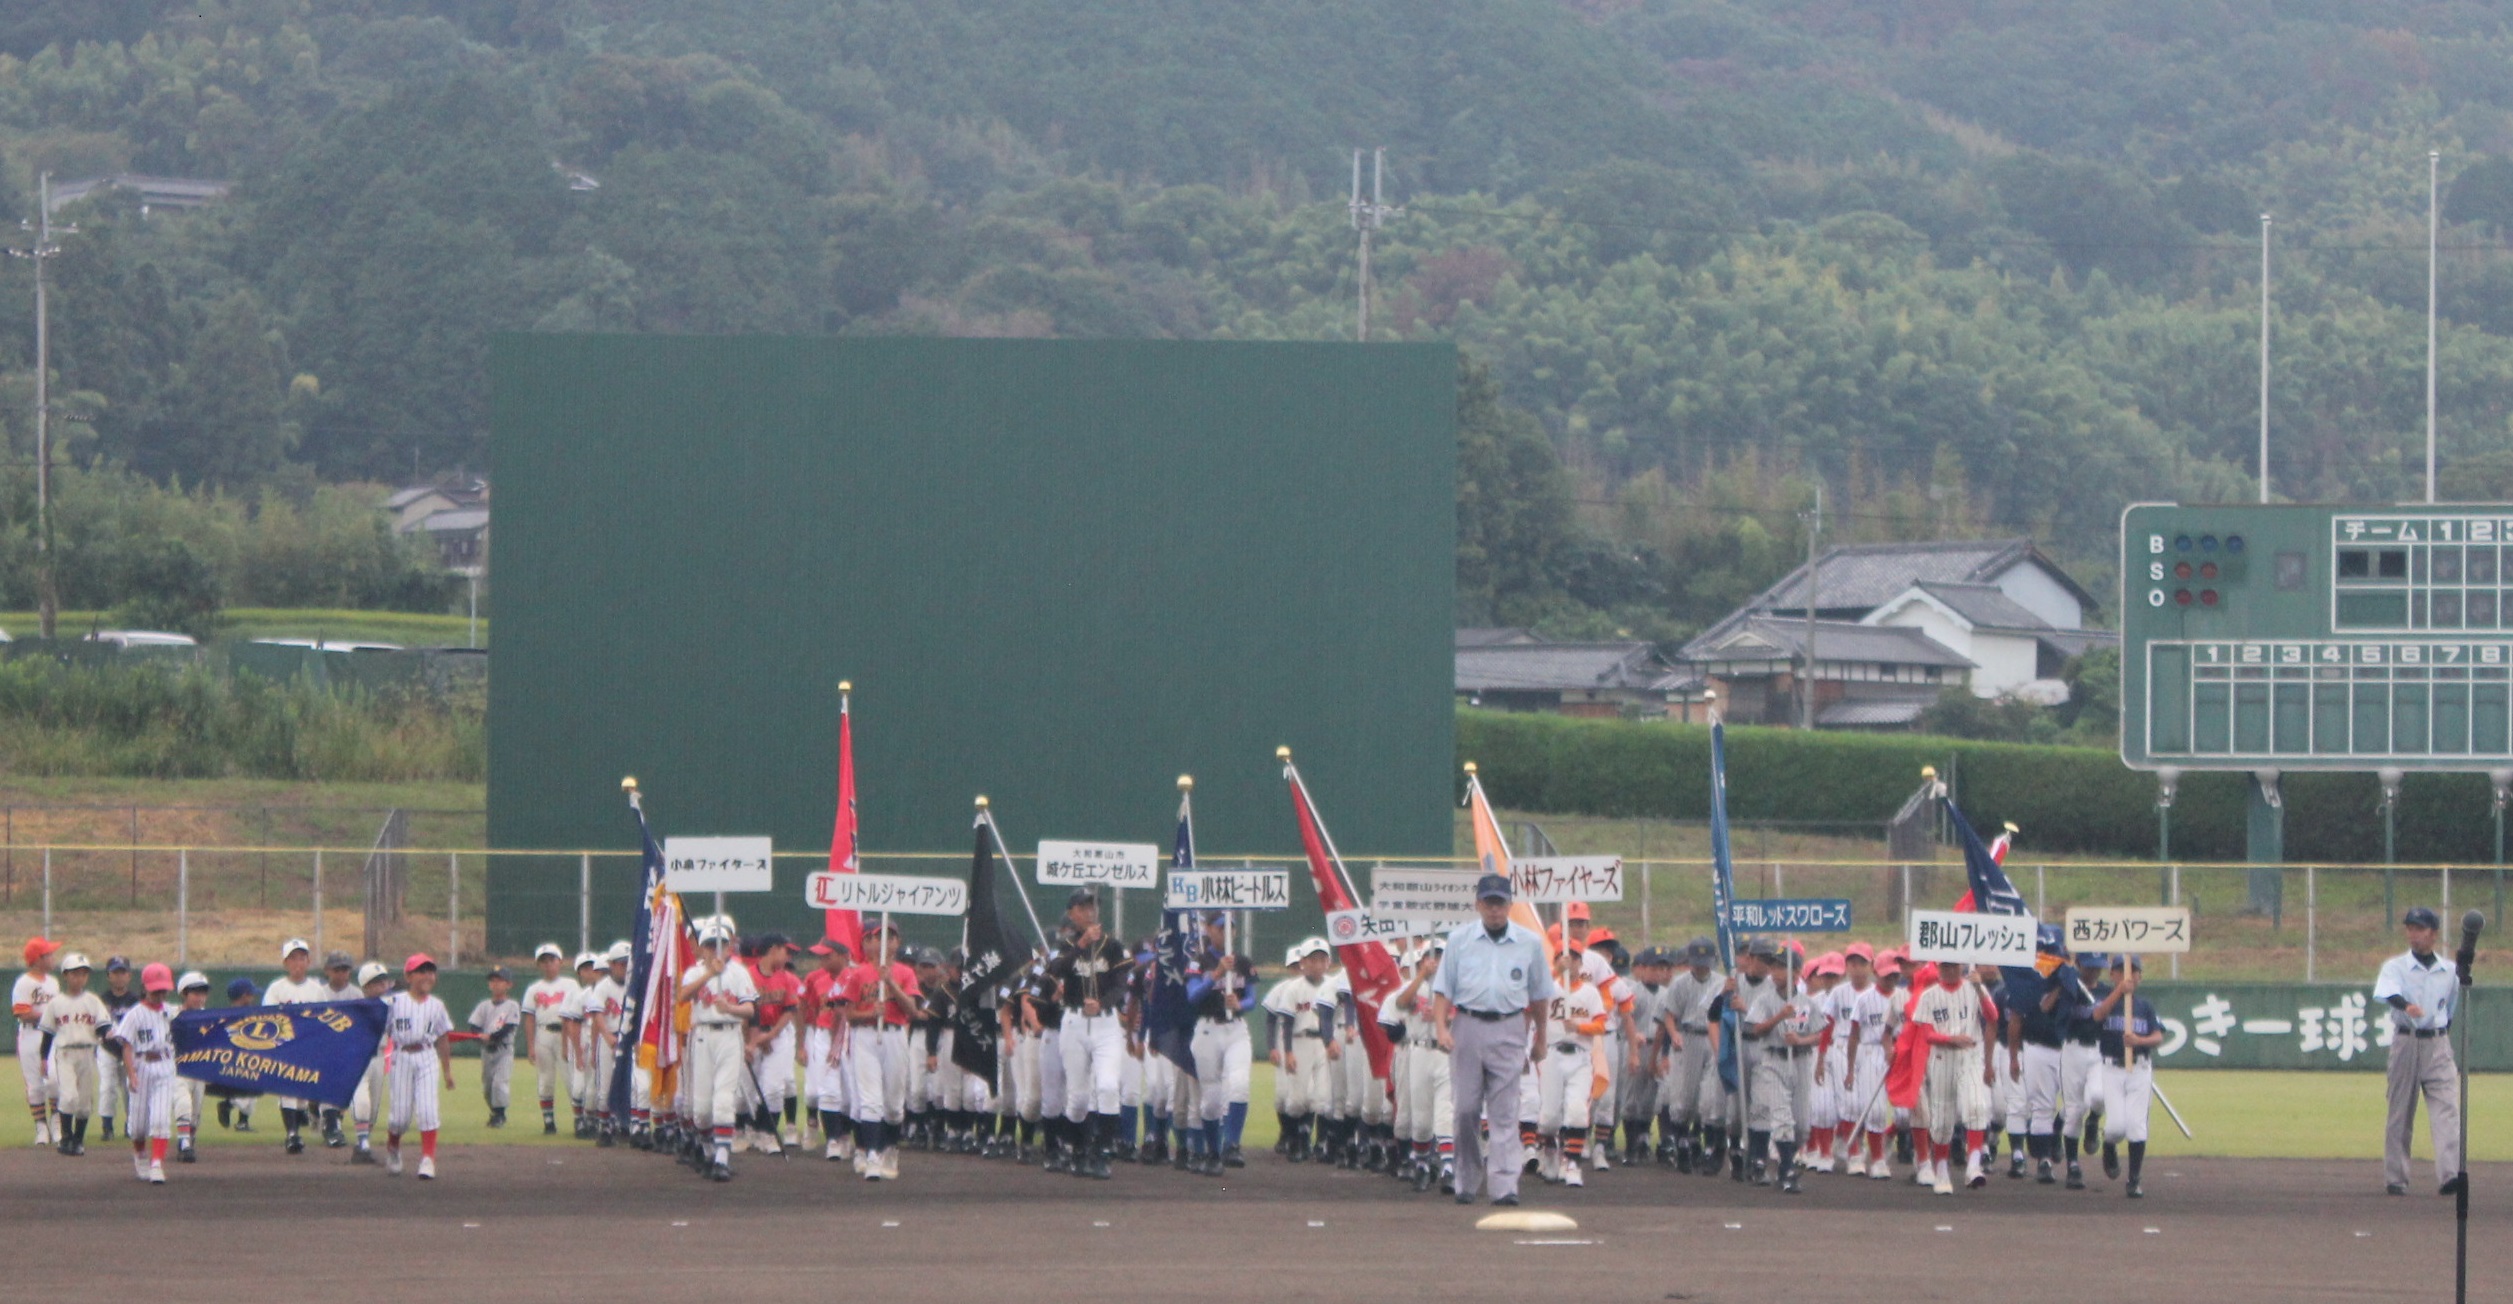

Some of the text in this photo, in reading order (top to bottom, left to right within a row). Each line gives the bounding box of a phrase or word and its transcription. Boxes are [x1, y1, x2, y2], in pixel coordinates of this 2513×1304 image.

[2345, 521, 2418, 541] チーム
[2439, 521, 2453, 541] 1
[2470, 521, 2493, 541] 2
[2150, 535, 2164, 554] B
[2150, 562, 2164, 581] S
[2149, 589, 2165, 607] O
[2207, 646, 2501, 662] 1 2 3 4 5 6 7 8
[841, 882, 961, 908] リトルジャイアンツ
[1200, 874, 1287, 904] 小林ビートルズ
[1732, 903, 1848, 927] 平和レッドスワローズ
[1919, 920, 2027, 952] 郡山フレッシュ
[219, 1066, 259, 1081] JAPAN
[235, 1052, 320, 1084] KORIYAMA
